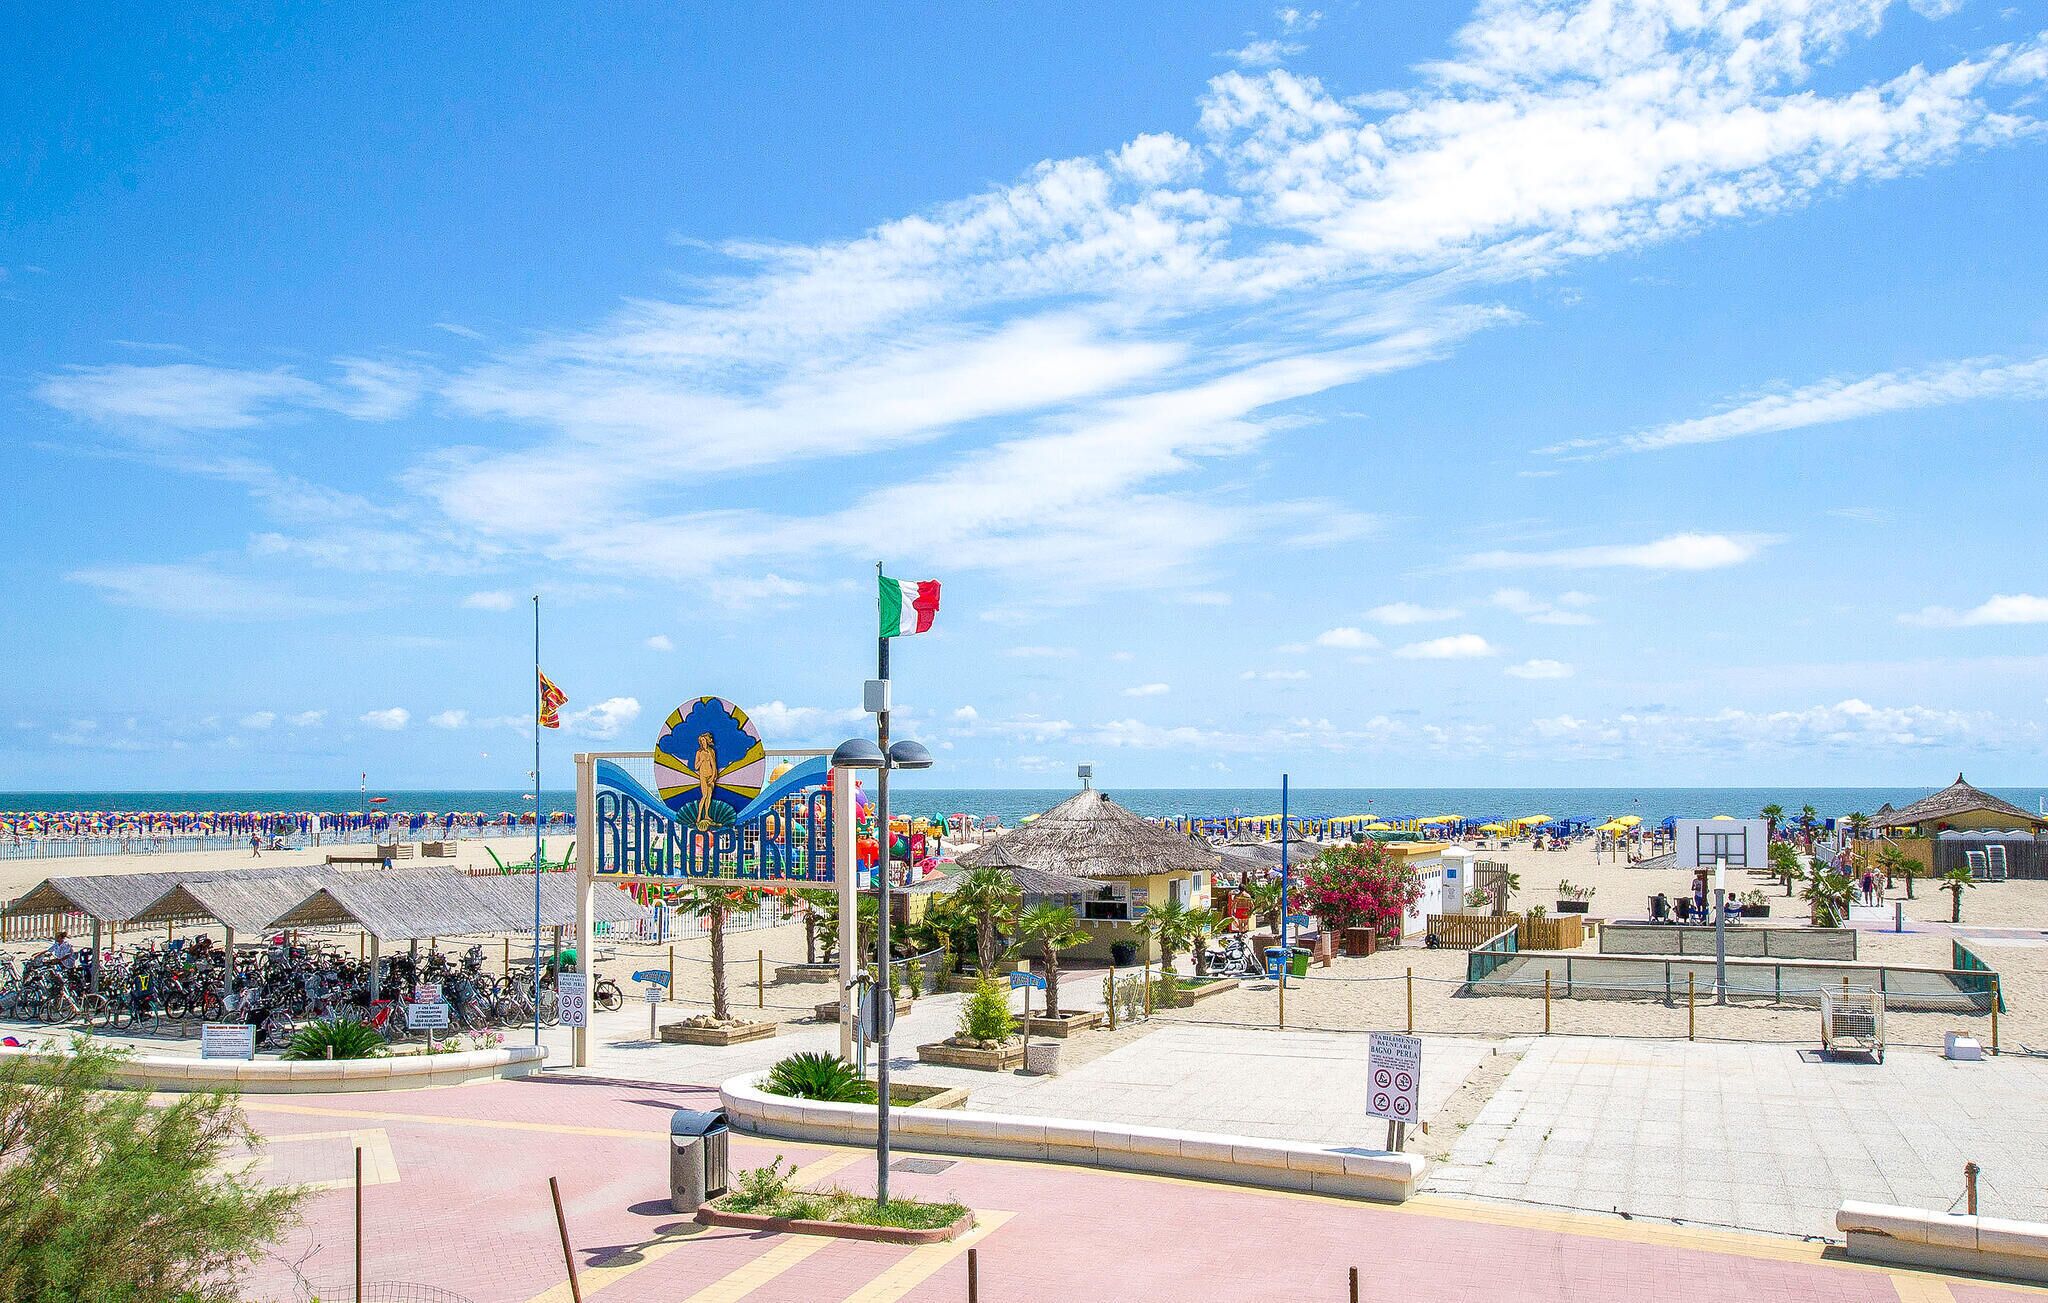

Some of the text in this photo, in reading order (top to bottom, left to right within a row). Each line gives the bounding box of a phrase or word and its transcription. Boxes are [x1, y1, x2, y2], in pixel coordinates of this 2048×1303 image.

[1370, 1034, 1419, 1045] STABILIMENTO
[1377, 1041, 1413, 1050] BALNEARE
[1370, 1046, 1418, 1059] BAGNO PERLA
